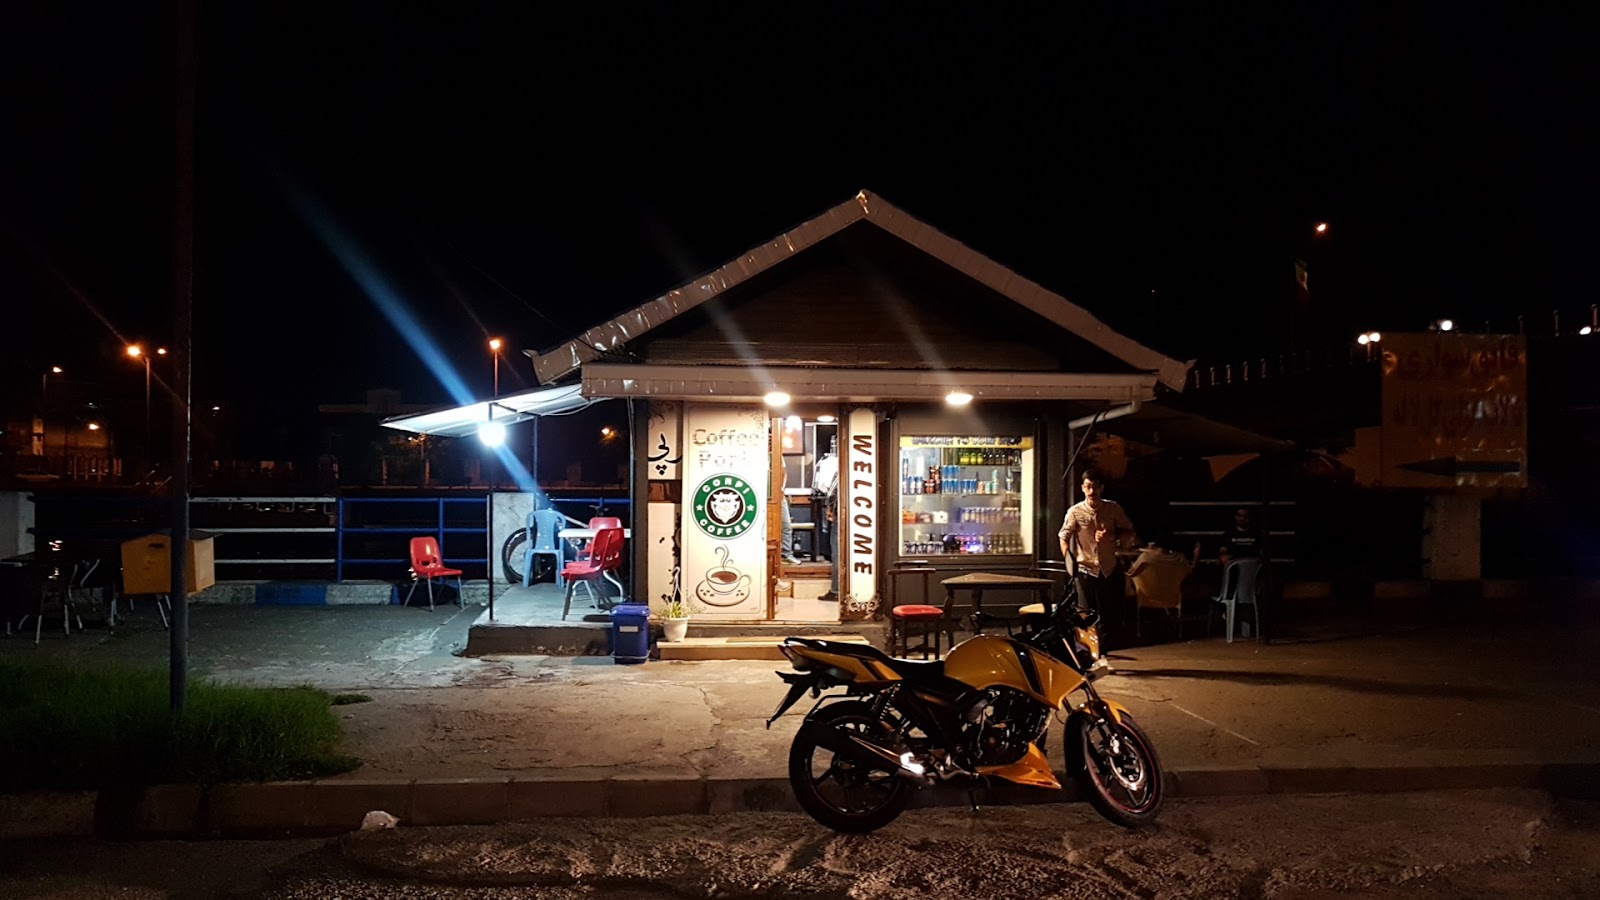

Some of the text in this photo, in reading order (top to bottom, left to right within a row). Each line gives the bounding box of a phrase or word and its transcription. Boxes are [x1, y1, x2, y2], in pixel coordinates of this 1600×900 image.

[692, 428, 760, 447] Coffee
[702, 477, 750, 495] CORPI
[852, 434, 873, 575] WELCOME
[699, 518, 750, 536] COFFEE
